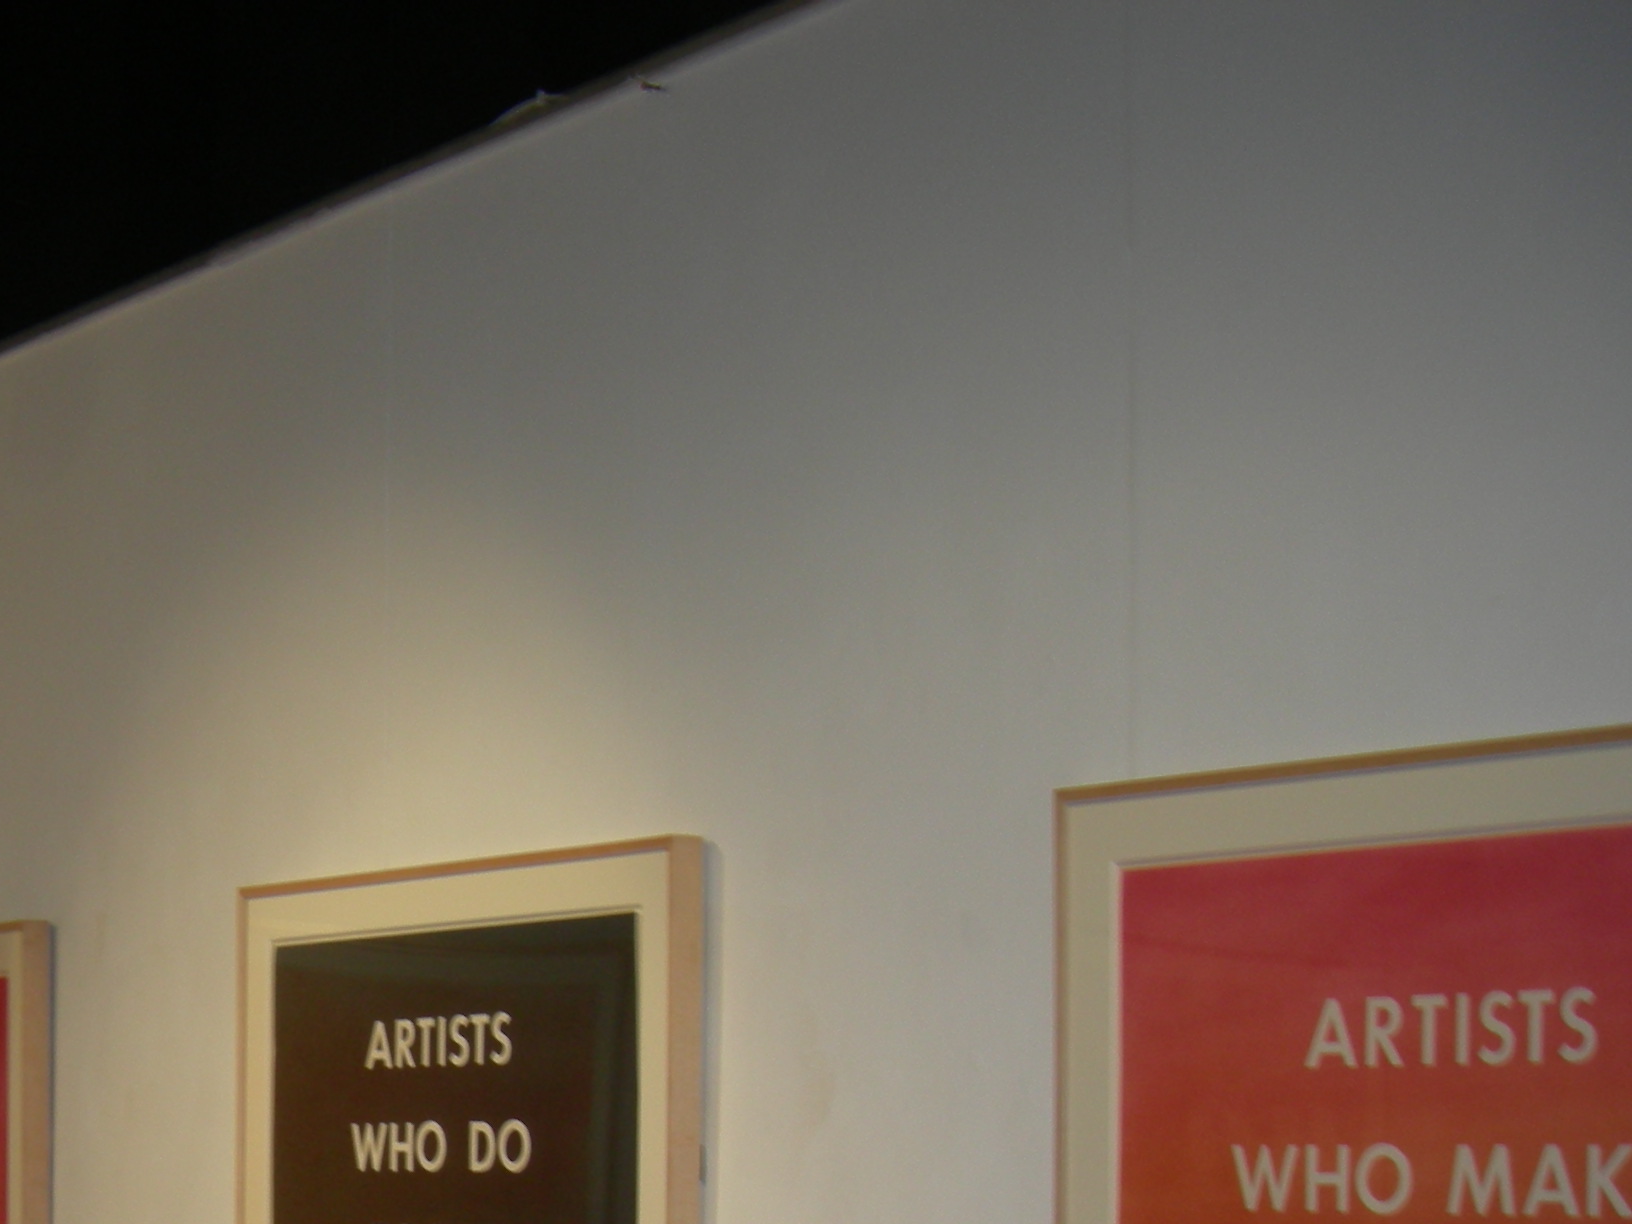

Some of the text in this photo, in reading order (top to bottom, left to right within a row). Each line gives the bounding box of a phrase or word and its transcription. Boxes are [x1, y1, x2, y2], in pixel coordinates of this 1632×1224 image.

[365, 1012, 513, 1070] ARTISTS
[1304, 986, 1597, 1070] ARTISTS
[350, 1118, 532, 1173] WHO DO
[1230, 1142, 1414, 1217] WHO
